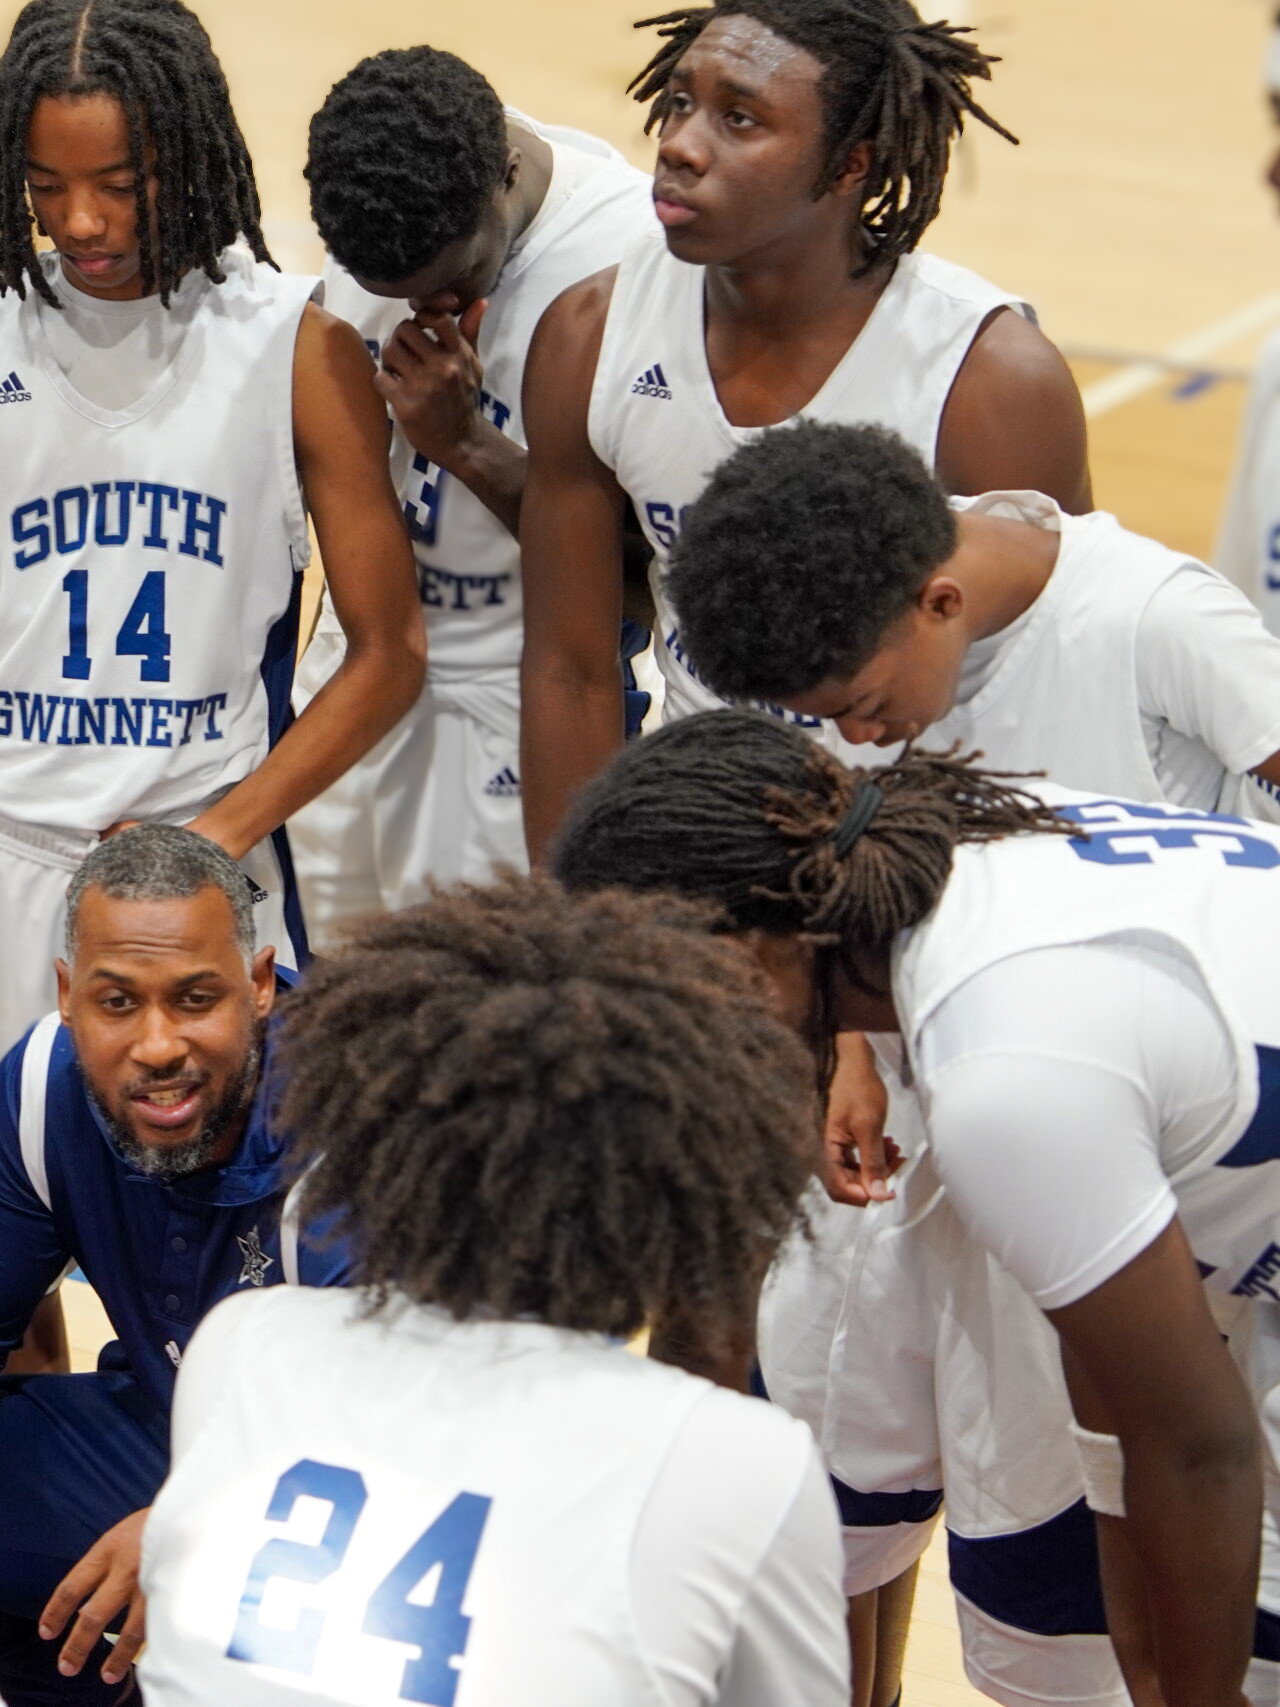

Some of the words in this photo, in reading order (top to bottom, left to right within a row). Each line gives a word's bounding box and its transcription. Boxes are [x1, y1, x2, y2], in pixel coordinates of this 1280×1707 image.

[631, 383, 672, 400] adidas
[10, 480, 228, 571] SOUTH
[61, 569, 171, 683] 14
[224, 1457, 495, 1707] 24
